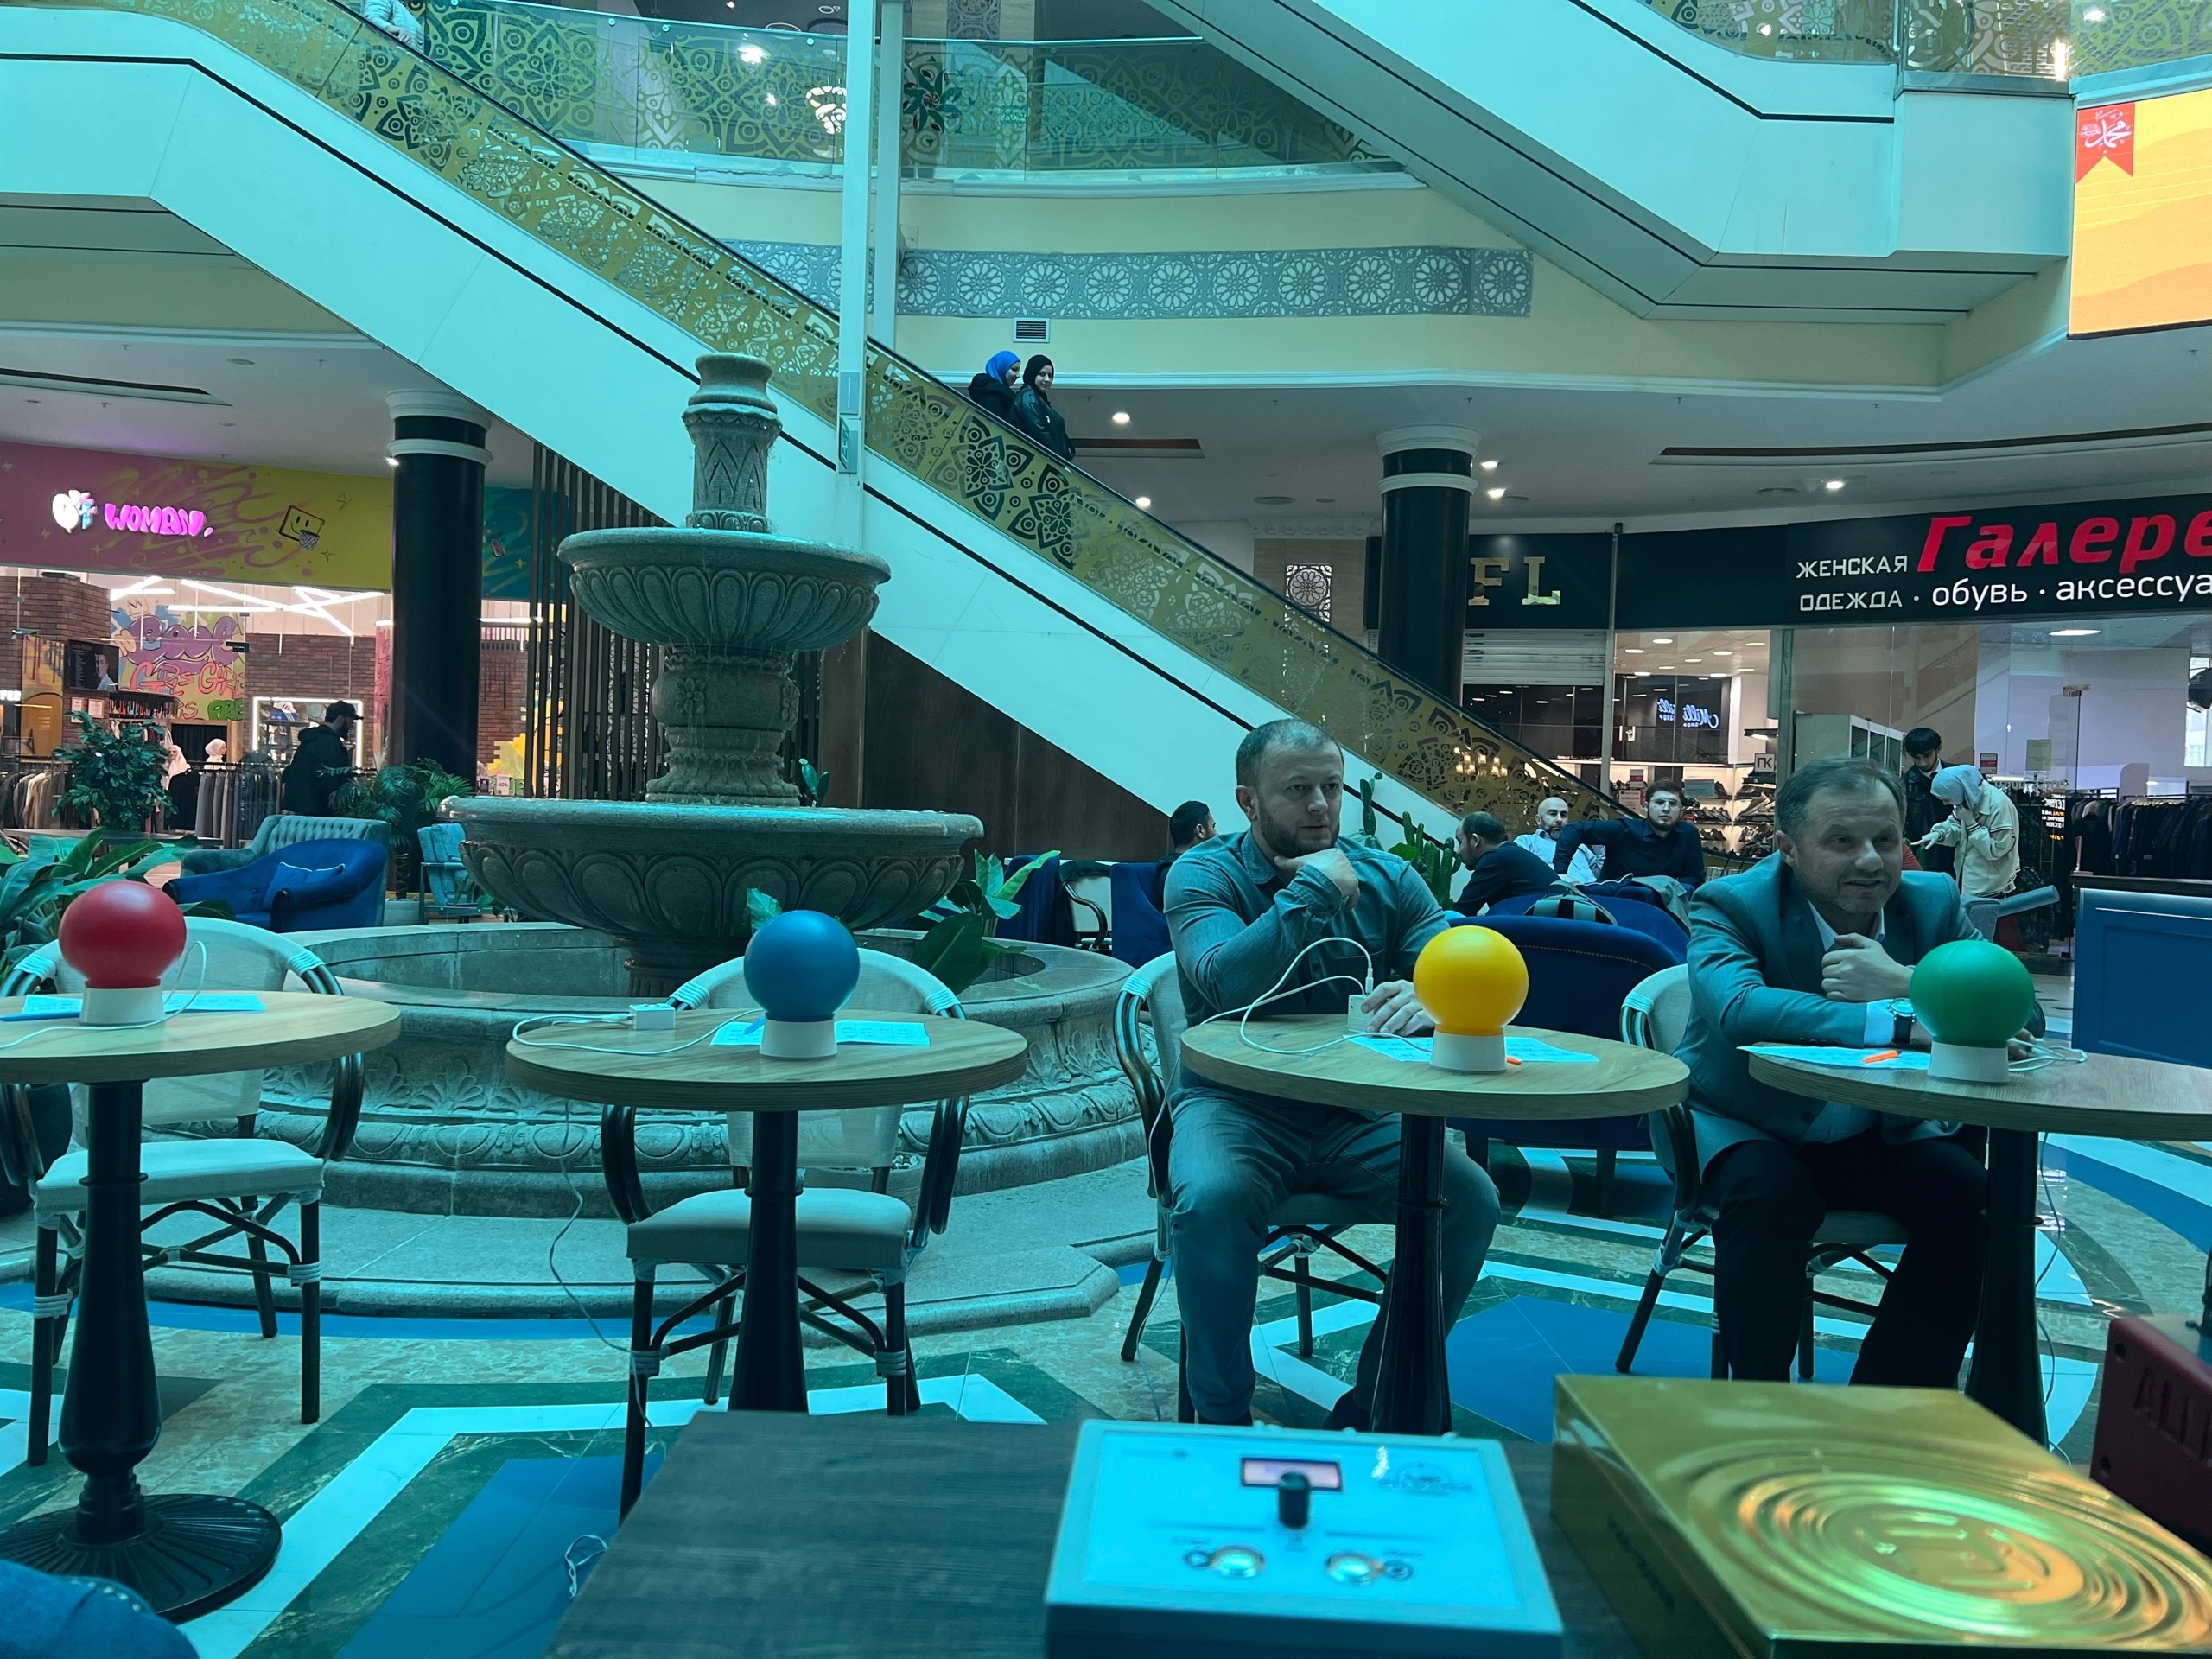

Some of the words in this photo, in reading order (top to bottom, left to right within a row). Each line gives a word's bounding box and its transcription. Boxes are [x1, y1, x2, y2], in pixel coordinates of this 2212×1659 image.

[1796, 555, 1908, 579] ЖЕНСКАЯ
[1800, 589, 1903, 612] ОДЕЖДА
[1932, 577, 2028, 611] обувь
[1757, 757, 1773, 769] ПК
